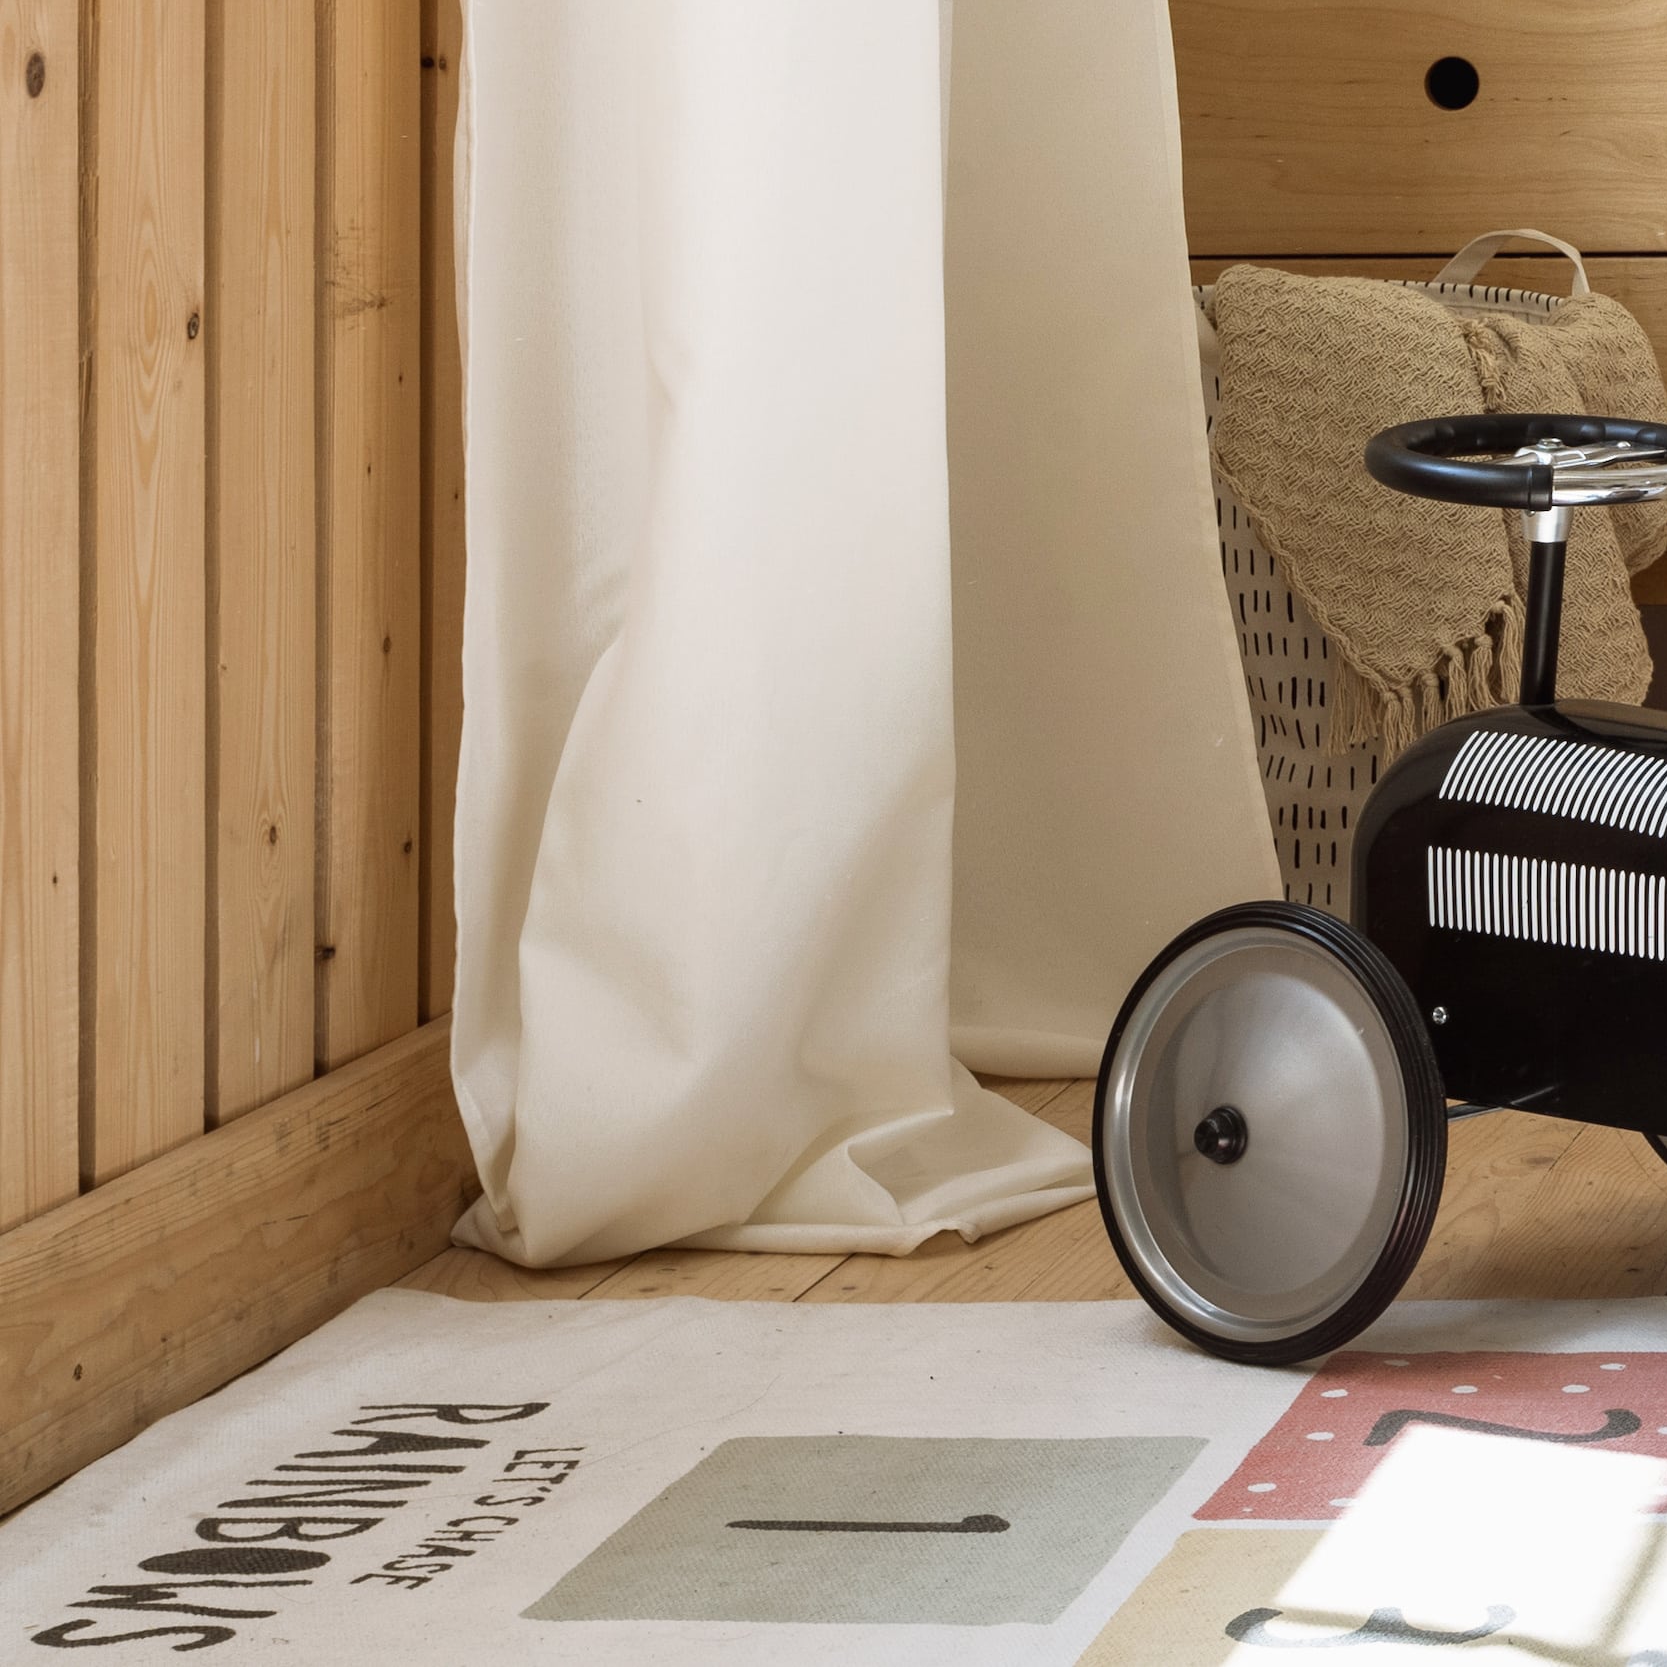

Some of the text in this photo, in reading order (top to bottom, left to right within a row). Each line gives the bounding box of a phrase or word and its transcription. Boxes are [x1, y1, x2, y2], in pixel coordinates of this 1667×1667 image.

[1364, 1408, 1642, 1447] 2
[30, 1402, 551, 1652] RAINBOWS
[349, 1446, 586, 1590] LET'S CHASE
[724, 1514, 1011, 1534] 1
[1225, 1605, 1517, 1649] 3
